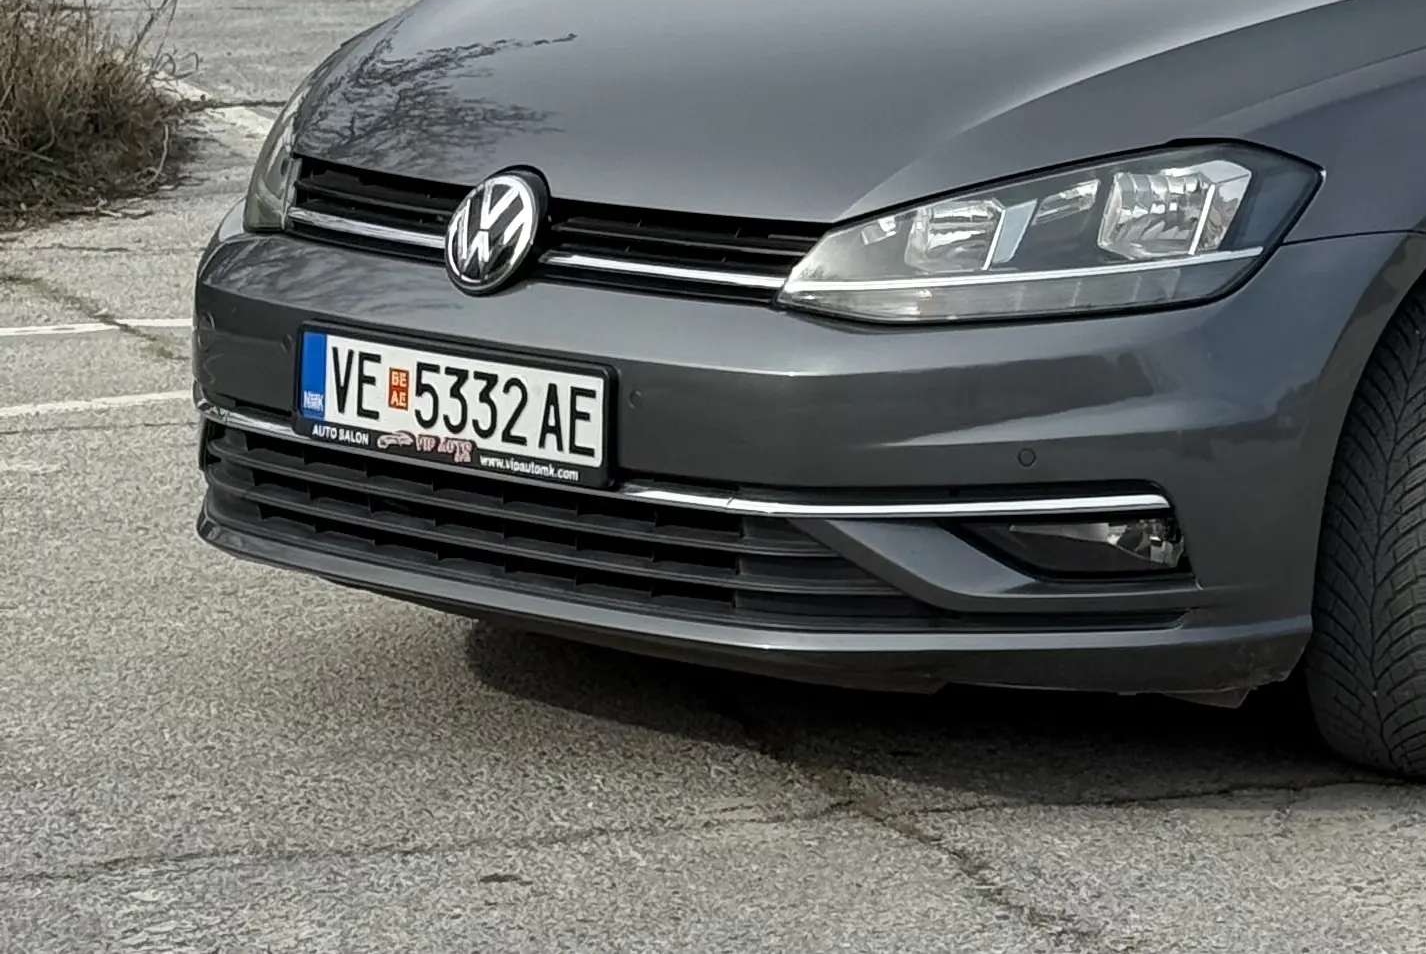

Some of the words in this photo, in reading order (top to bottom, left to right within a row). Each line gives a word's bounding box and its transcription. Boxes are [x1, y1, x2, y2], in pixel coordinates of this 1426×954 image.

[331, 345, 382, 420] VE
[414, 361, 529, 447] 5332
[538, 382, 597, 458] AE
[312, 424, 337, 441] AUTO
[338, 427, 369, 446] SALON
[415, 434, 437, 452] VIP
[479, 454, 579, 482] www.vipautomk.com
